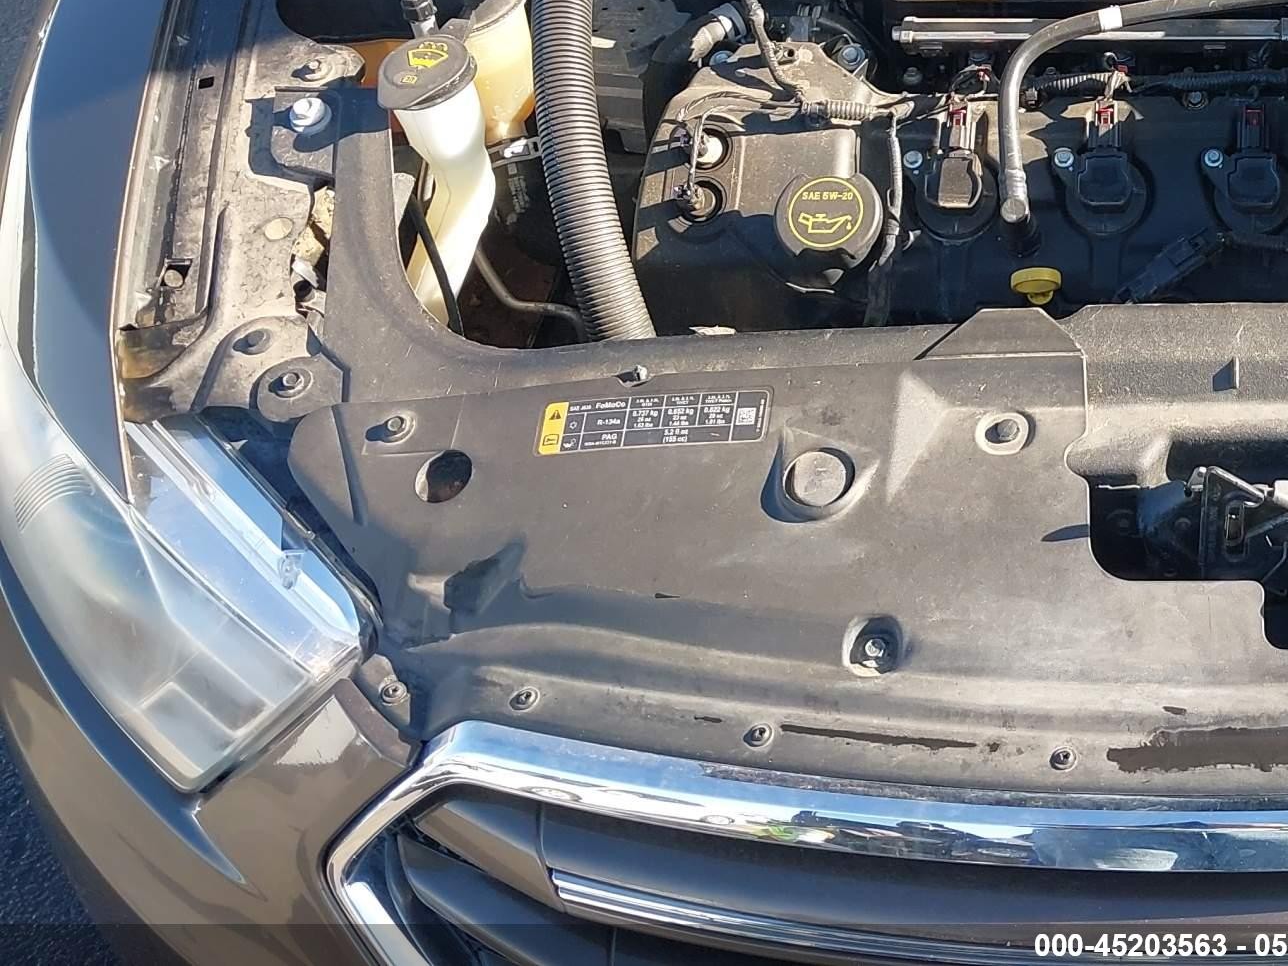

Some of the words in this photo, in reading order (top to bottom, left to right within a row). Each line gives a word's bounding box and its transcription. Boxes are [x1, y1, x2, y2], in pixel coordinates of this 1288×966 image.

[802, 192, 820, 200] SAE
[822, 192, 854, 200] 5W-20
[596, 401, 626, 409] FoMoCo
[650, 410, 659, 418] kg
